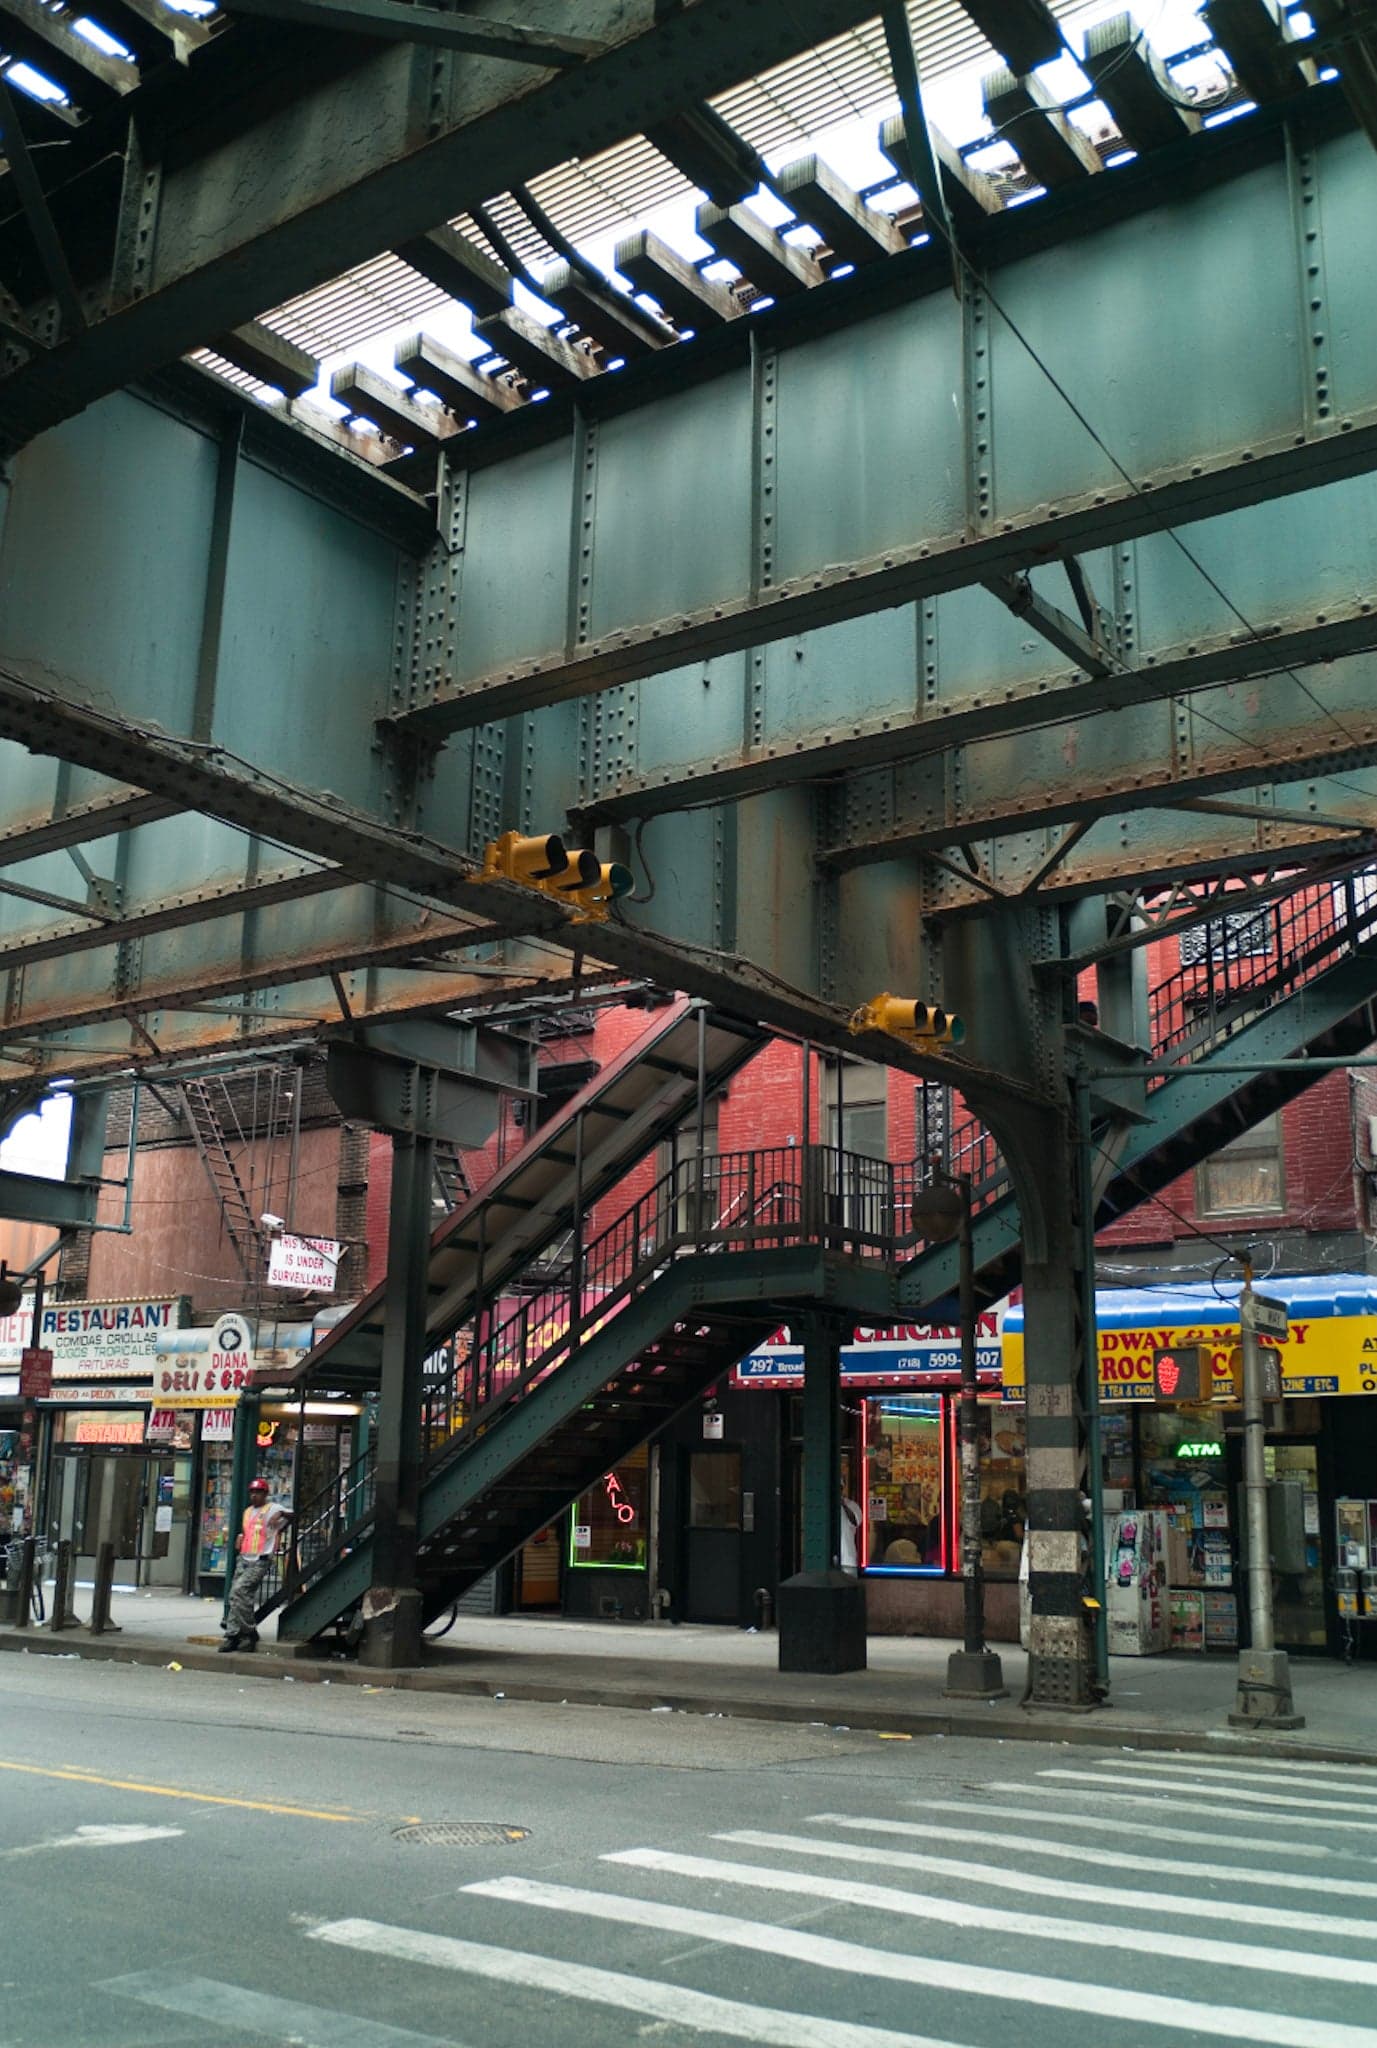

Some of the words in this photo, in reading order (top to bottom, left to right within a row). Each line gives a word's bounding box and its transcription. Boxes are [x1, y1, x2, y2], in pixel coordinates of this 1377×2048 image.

[280, 1236, 297, 1249] THIS
[286, 1254, 293, 1266] IS
[297, 1255, 324, 1271] UNDER
[272, 1269, 333, 1287] SURVEILLANCE
[43, 1303, 172, 1333] RESTAURANT
[56, 1333, 102, 1347] COMIDAS
[107, 1332, 157, 1345] CRIOLLAS
[1101, 1331, 1175, 1351] DWAY
[53, 1347, 88, 1359] JUGOS
[94, 1344, 157, 1356] TROPICALES
[212, 1353, 249, 1369] DIANA
[749, 1359, 774, 1373] 297
[777, 1361, 805, 1373] Broad
[1359, 1363, 1377, 1375] PL
[161, 1371, 199, 1392] DELI
[205, 1409, 232, 1428] ATM
[1176, 1443, 1221, 1457] ATM
